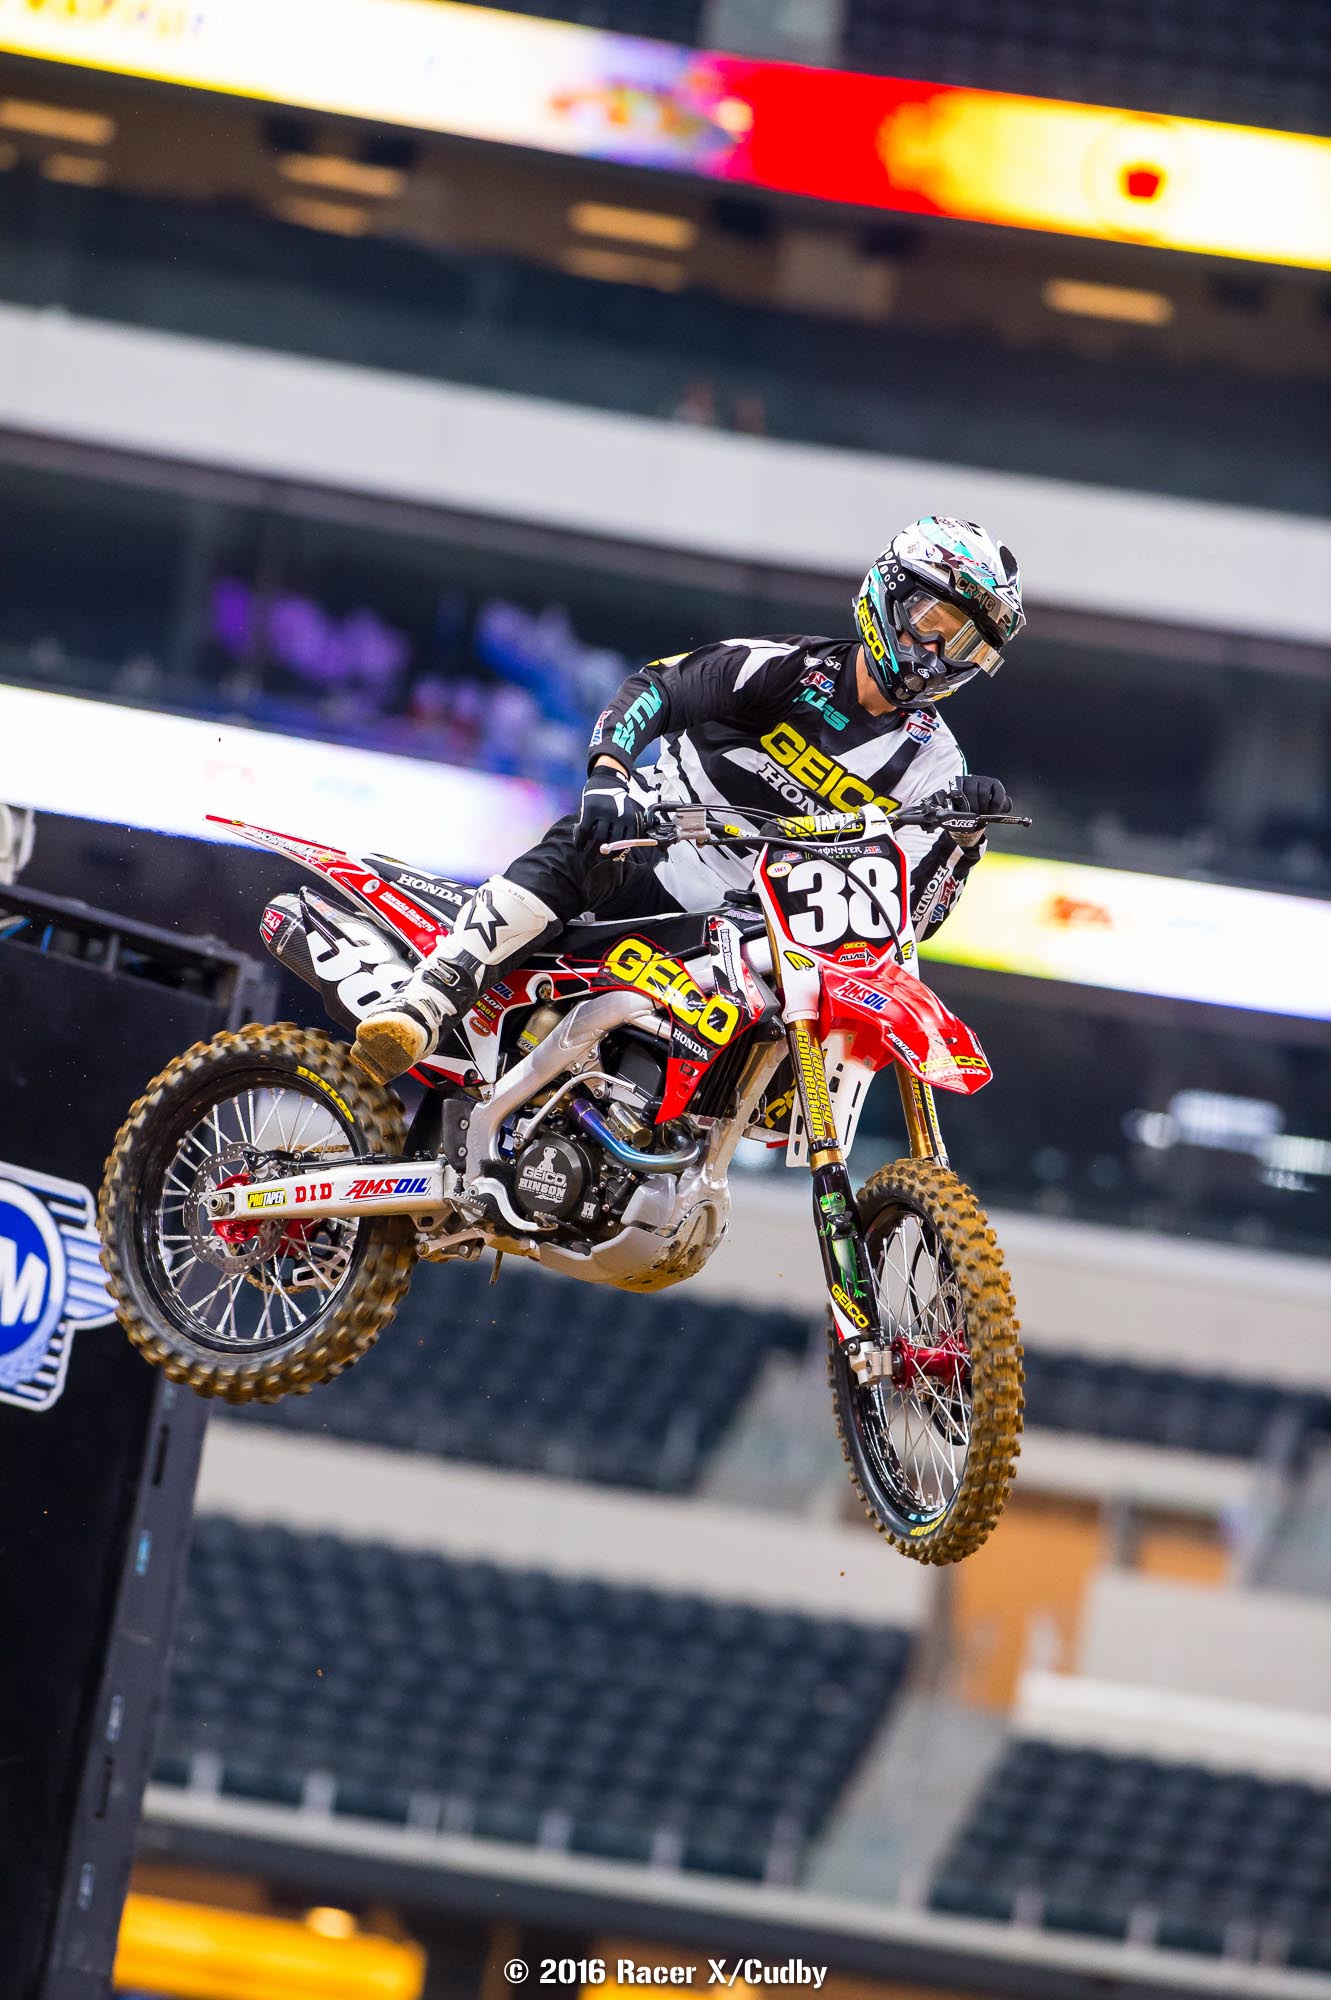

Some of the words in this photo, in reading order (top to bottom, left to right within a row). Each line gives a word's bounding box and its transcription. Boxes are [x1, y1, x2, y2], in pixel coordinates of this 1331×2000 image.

[956, 576, 996, 612] CRAIG
[857, 598, 886, 661] GEICO
[757, 762, 830, 817] HON
[396, 873, 463, 906] HONDA
[787, 857, 900, 946] 38
[911, 866, 949, 922] HONDA
[382, 891, 408, 912] Honda
[408, 908, 436, 932] Racing
[604, 938, 739, 1046] GEICO
[836, 981, 889, 1010] AMSOIL
[672, 1027, 708, 1061] HONDA
[886, 1032, 920, 1060] DUNLOP
[345, 1176, 431, 1203] AMSOIL
[518, 1177, 567, 1200] HINSON
[522, 1165, 567, 1188] GEICO
[249, 1189, 286, 1209] PROTAPER
[831, 1284, 870, 1330] GEICO
